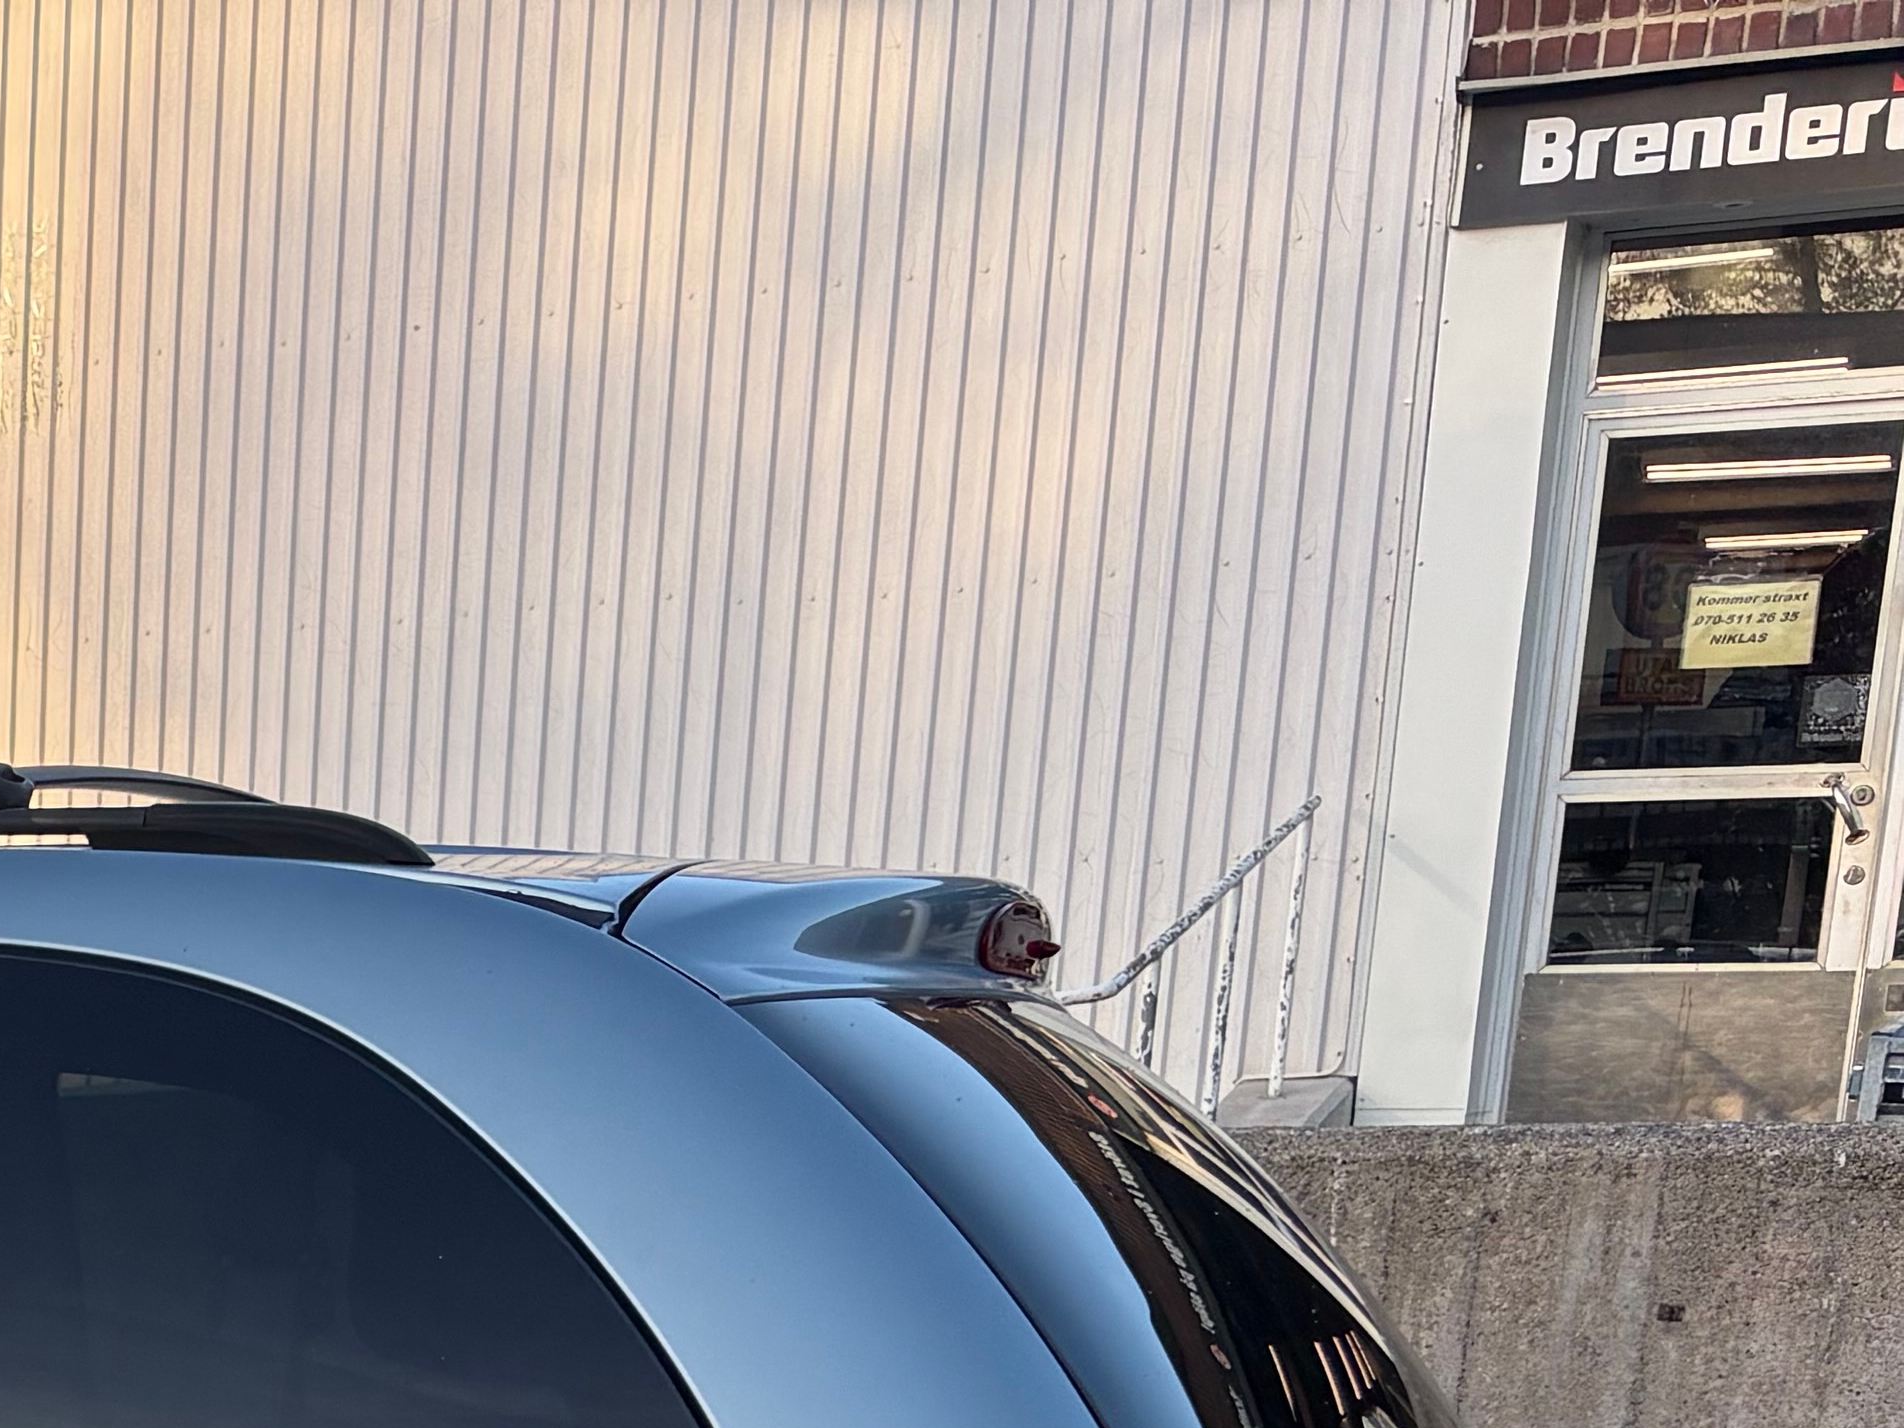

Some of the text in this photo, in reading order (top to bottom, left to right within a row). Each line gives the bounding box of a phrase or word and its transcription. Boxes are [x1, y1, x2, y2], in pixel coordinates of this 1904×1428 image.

[1520, 92, 1904, 186] Brender
[1695, 593, 1761, 608] Kommer
[1756, 611, 1777, 624] 26
[1779, 610, 1801, 623] 35
[1709, 631, 1769, 646] NIKLAS
